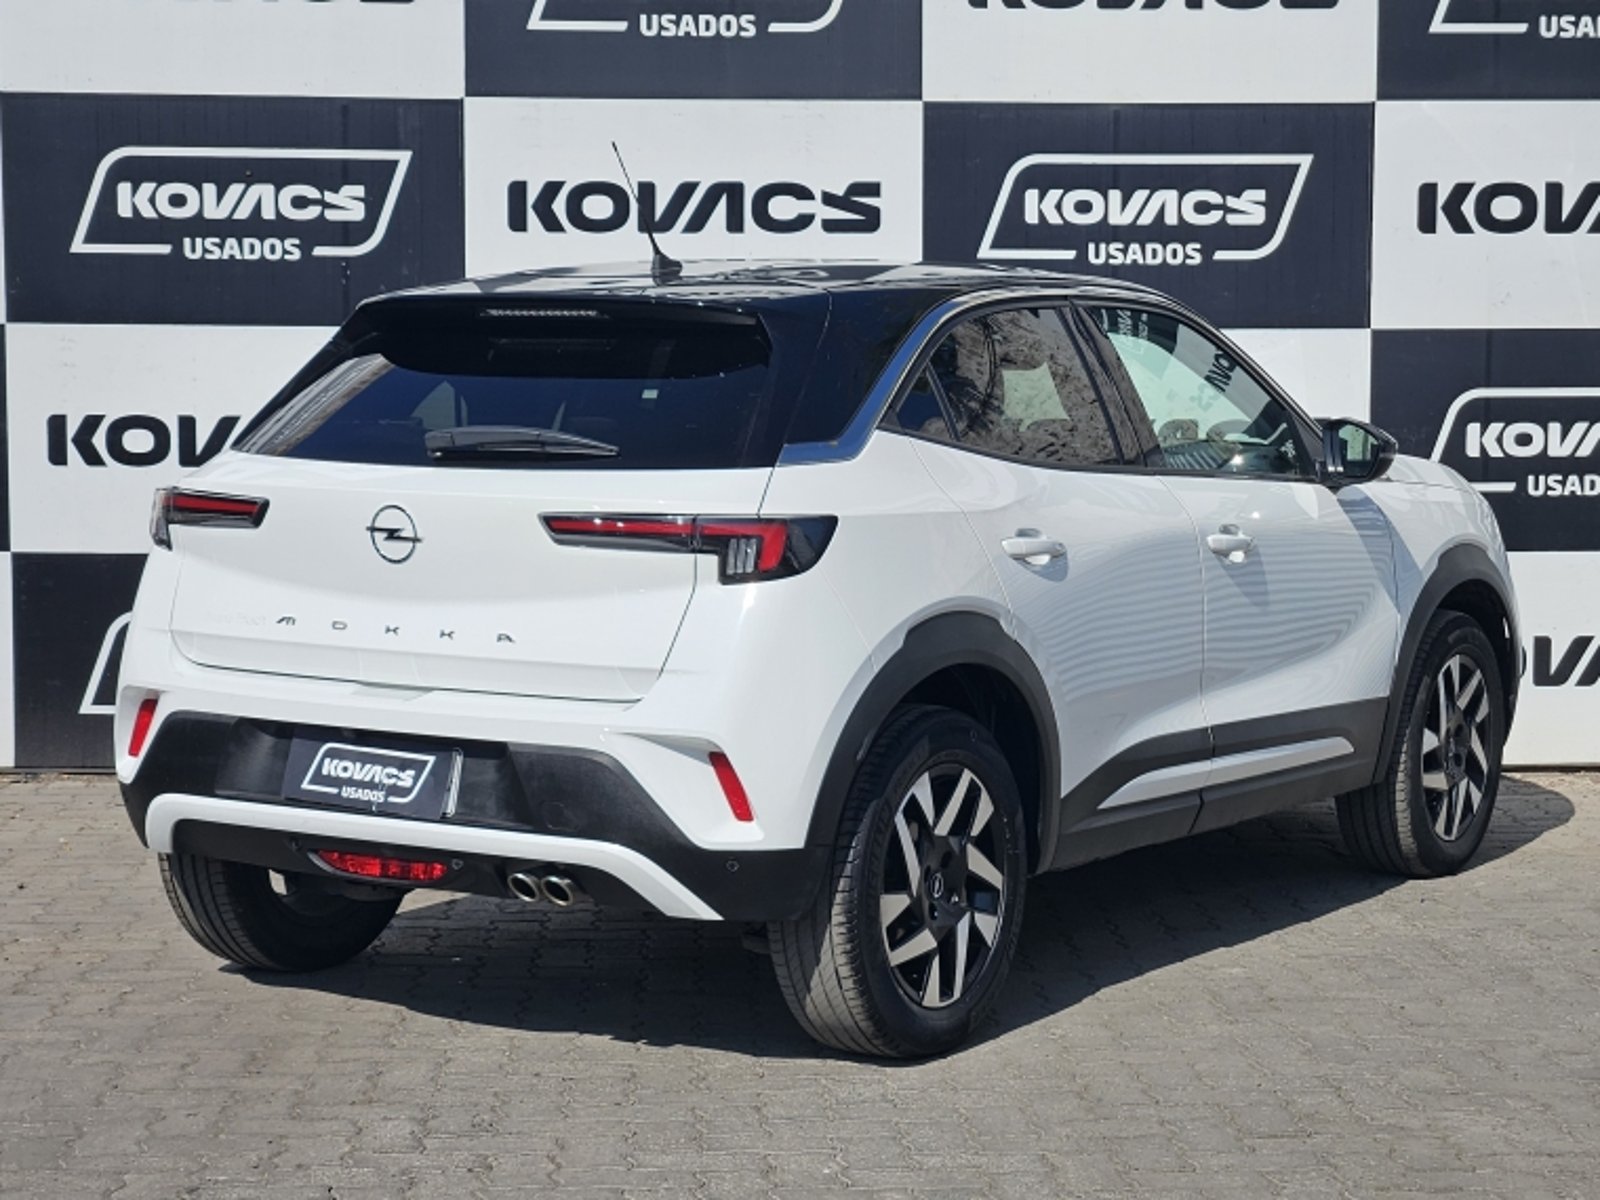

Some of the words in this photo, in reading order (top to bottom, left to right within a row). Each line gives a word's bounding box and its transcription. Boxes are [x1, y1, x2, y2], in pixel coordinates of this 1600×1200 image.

[639, 13, 757, 38] USADOS
[1539, 15, 1600, 39] USA
[116, 181, 366, 222] KOVACS
[507, 180, 881, 234] KOVACS
[1024, 188, 1266, 226] KOVACS
[183, 237, 302, 261] USADOS
[1087, 242, 1203, 266] USADOS
[320, 756, 416, 789] KOVACS
[340, 785, 387, 804] USADOS
